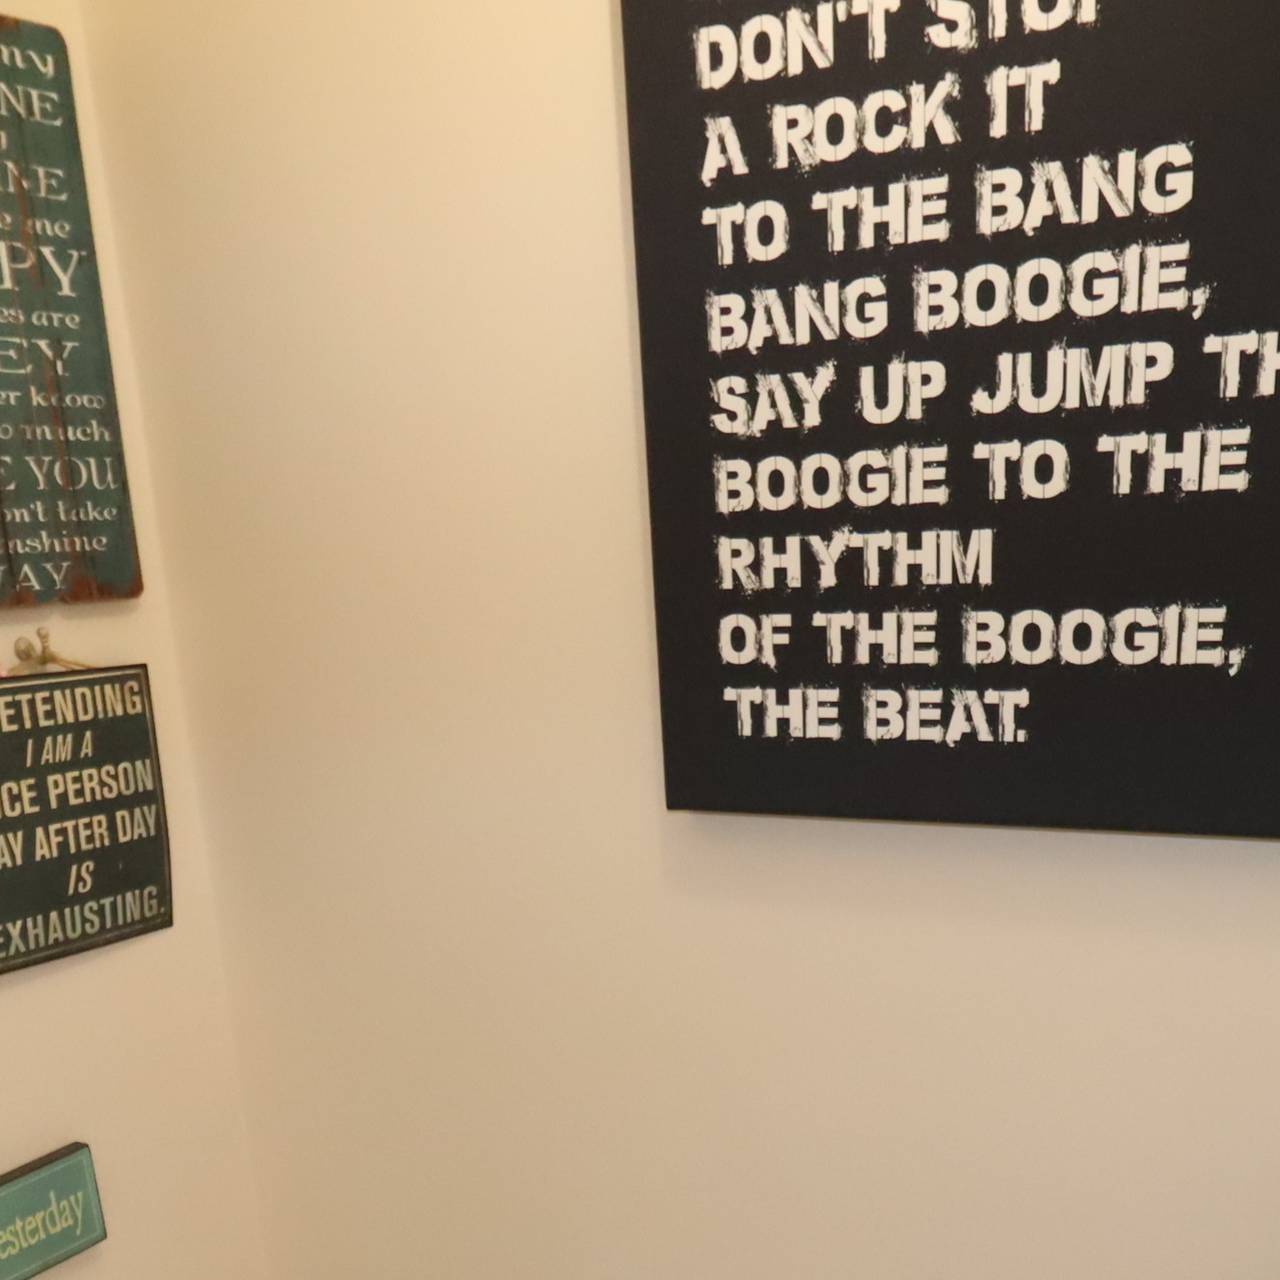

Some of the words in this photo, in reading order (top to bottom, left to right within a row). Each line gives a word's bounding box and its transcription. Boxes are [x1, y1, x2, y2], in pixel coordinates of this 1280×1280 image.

[693, 0, 901, 90] DON'T
[701, 116, 749, 187] A
[770, 72, 961, 172] ROCK
[984, 59, 1060, 138] IT
[23, 213, 71, 239] me
[701, 200, 789, 265] TO
[811, 174, 951, 255] THE
[975, 142, 1195, 236] BANG
[32, 309, 81, 330] are
[705, 275, 888, 355] BANG
[912, 240, 1212, 334] BOOGIE,
[31, 385, 105, 409] know
[710, 361, 837, 437] SAY
[859, 352, 946, 424] UP
[970, 340, 1174, 416] JUMP
[21, 419, 112, 442] much
[24, 455, 118, 491] YOU
[713, 443, 949, 514] BOOGIE
[973, 439, 1070, 499] TO
[1096, 424, 1251, 494] THE
[57, 500, 118, 523] take
[716, 526, 992, 594] RHYTHM
[719, 614, 791, 669] OF
[812, 610, 938, 666] THE
[962, 602, 1246, 676] BOOGIE,
[724, 684, 841, 740] THE
[862, 687, 1029, 747] BEAT.
[25, 738, 33, 768] I
[40, 733, 73, 765] AM
[80, 730, 94, 758] A
[46, 759, 154, 810] PERSON
[35, 814, 110, 862] AFTER
[116, 804, 157, 845] DAY
[67, 860, 95, 897] IS
